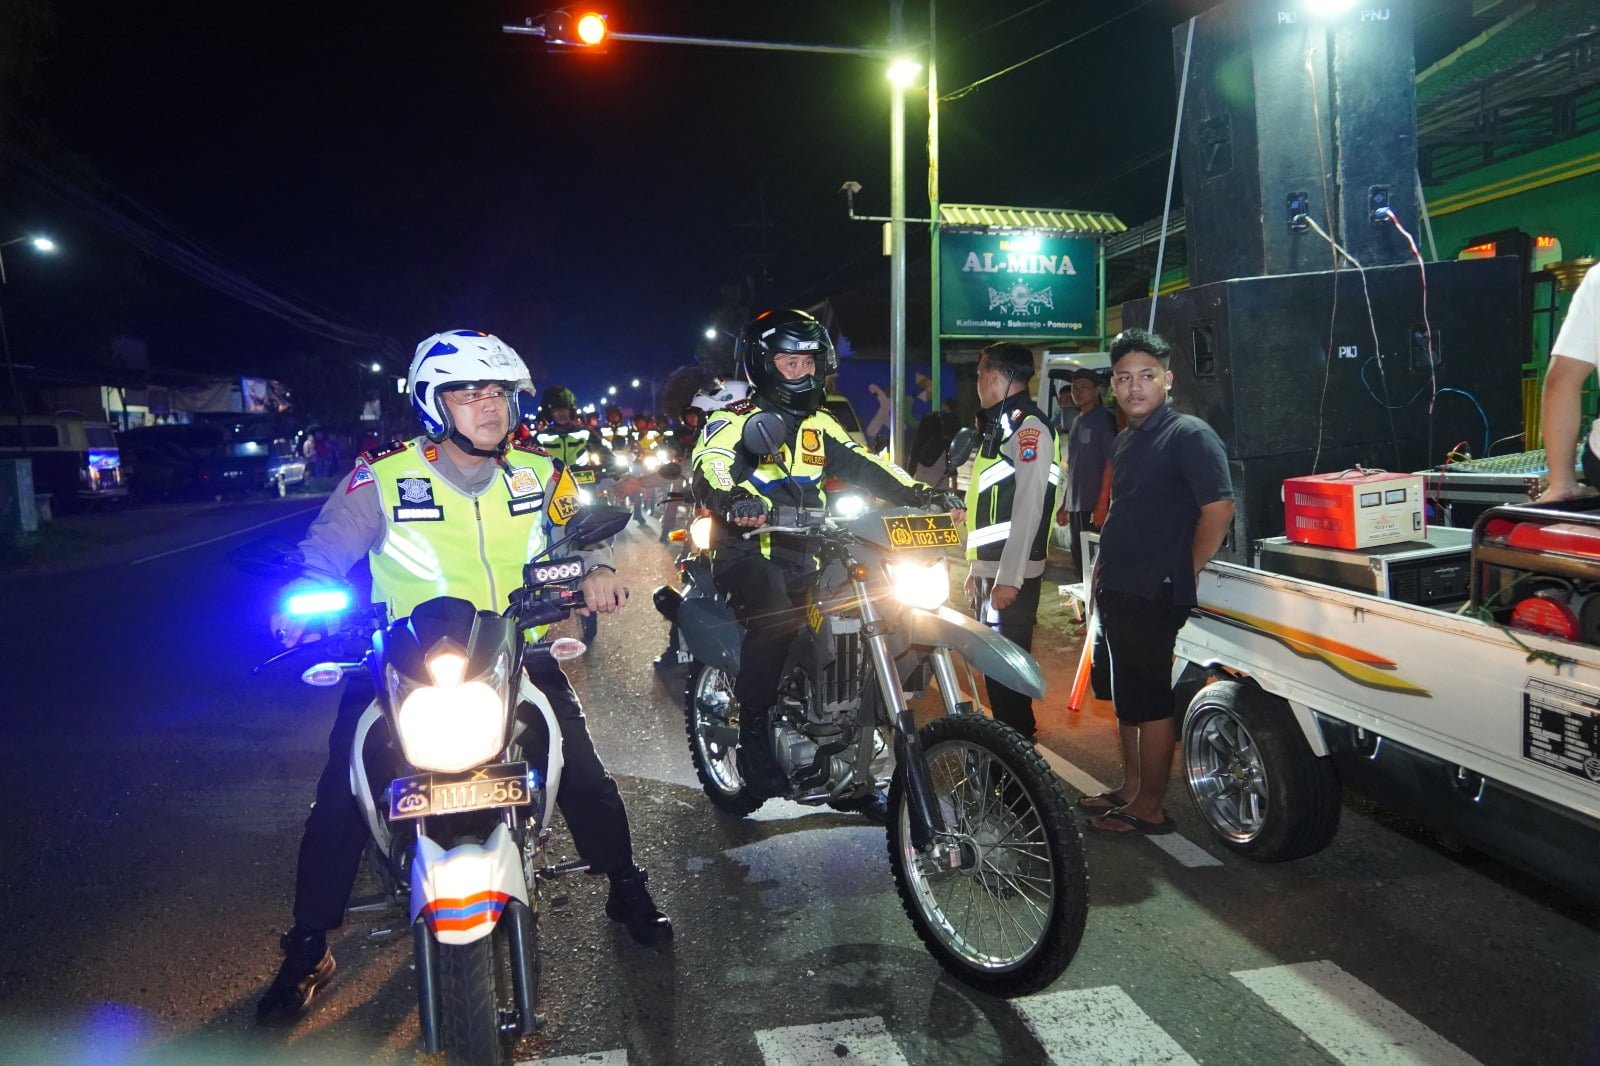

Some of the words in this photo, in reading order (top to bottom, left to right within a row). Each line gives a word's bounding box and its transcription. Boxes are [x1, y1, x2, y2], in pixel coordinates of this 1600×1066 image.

[962, 251, 1077, 275] AL-MINA
[956, 319, 1001, 329] Kalimalang
[1047, 320, 1083, 331] Ponorogo
[925, 518, 937, 530] X
[471, 768, 489, 780] X
